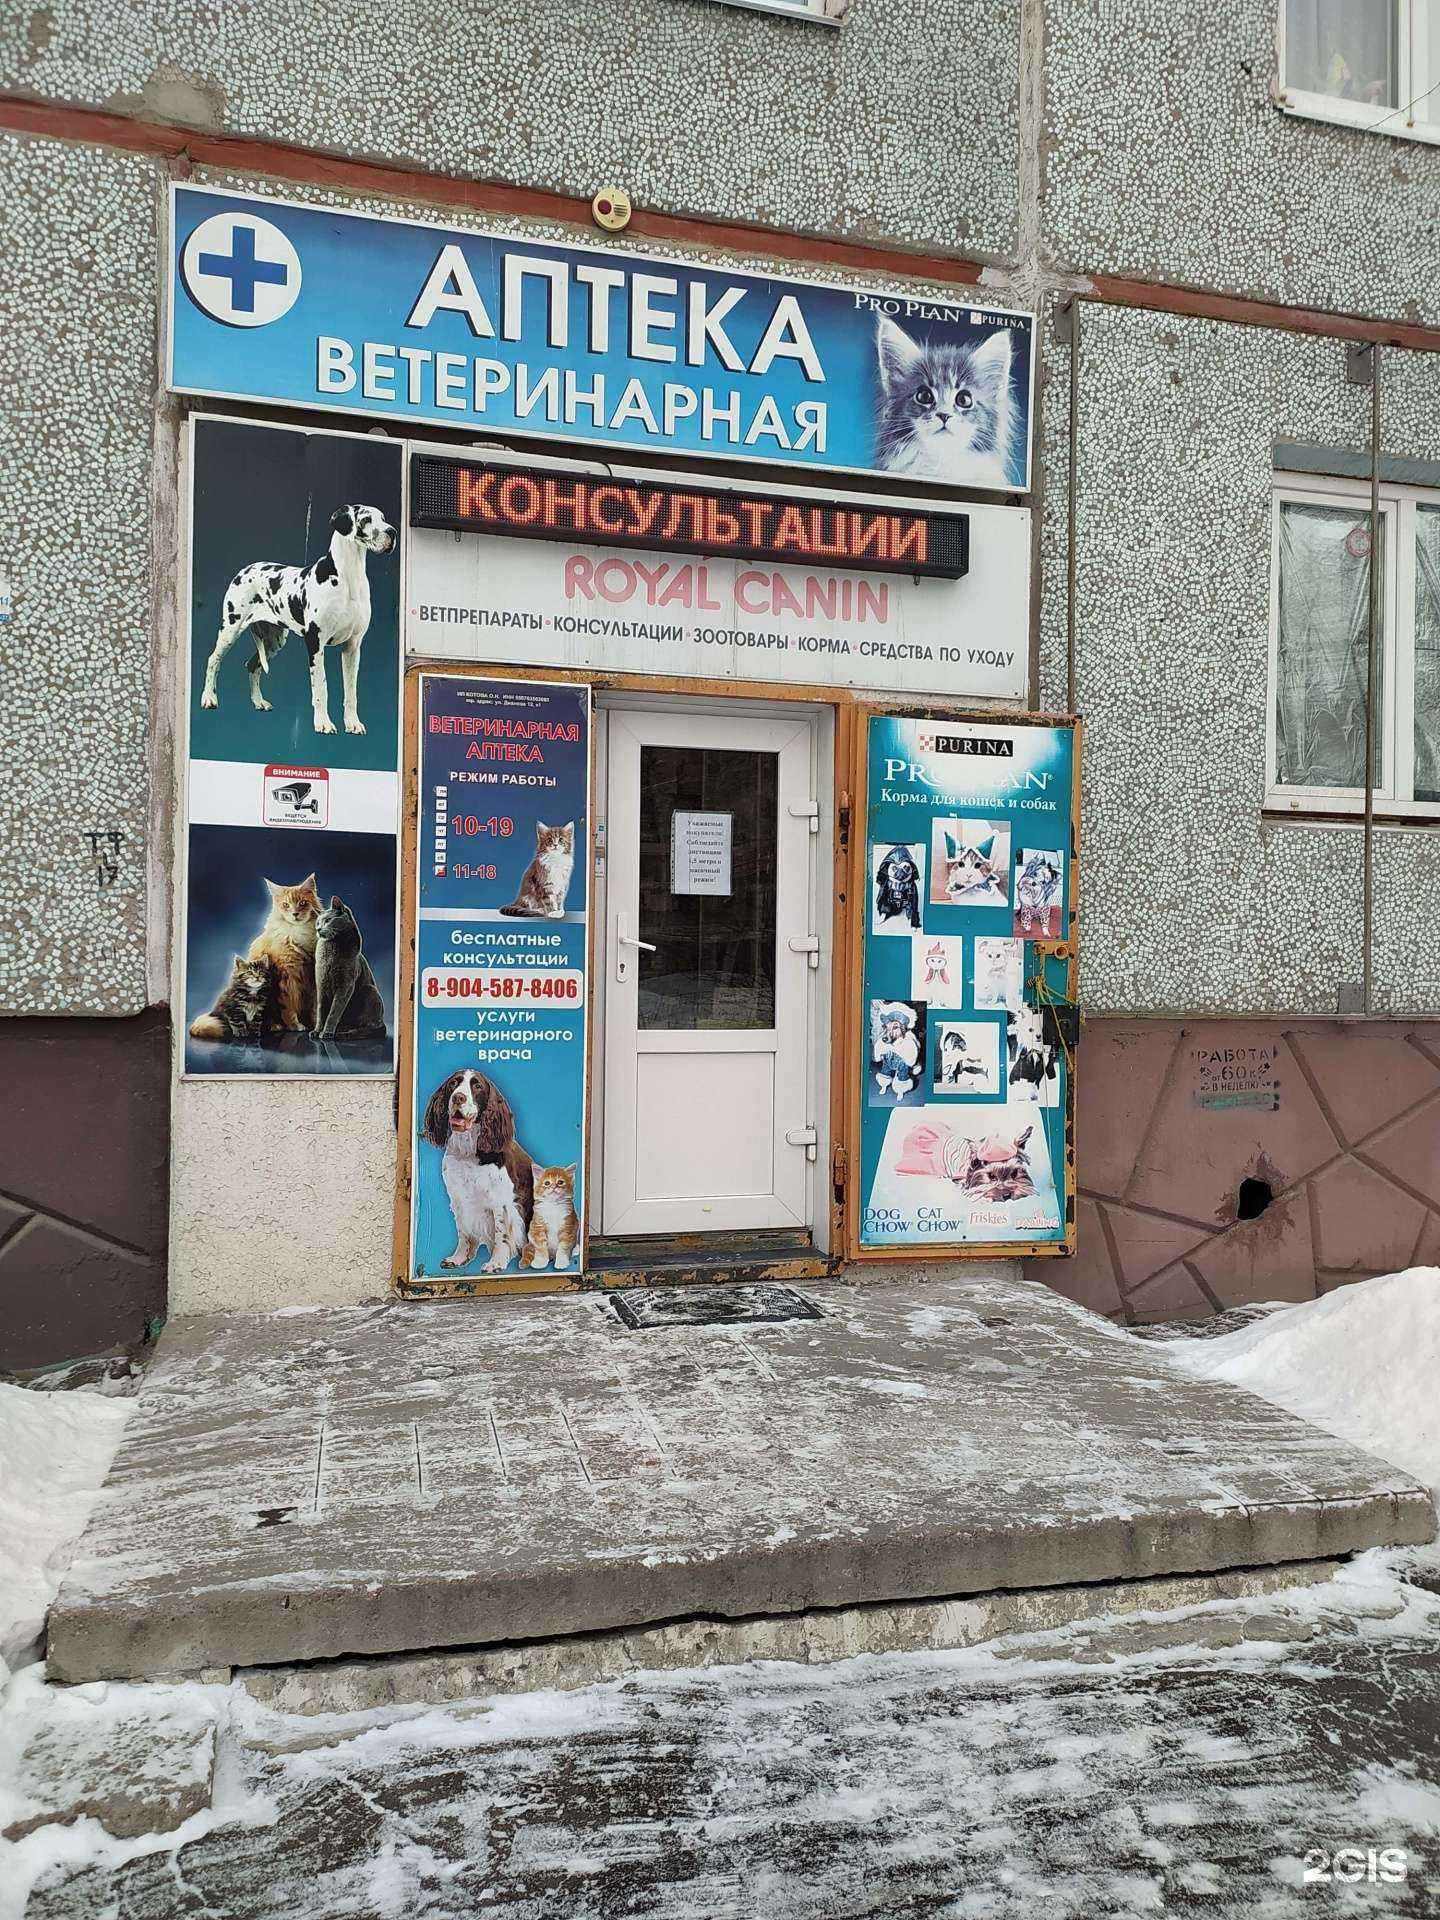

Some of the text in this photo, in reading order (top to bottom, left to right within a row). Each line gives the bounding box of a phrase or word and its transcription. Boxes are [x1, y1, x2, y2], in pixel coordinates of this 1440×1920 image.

[406, 244, 827, 382] АПТЕКА
[854, 293, 960, 323] PRO PLAN
[982, 315, 1025, 329] PURINA
[316, 335, 828, 454] ВЕТЕРИНАРНАЯ
[456, 467, 929, 563] КОНСУЛЬТАЦИИ
[564, 555, 889, 624] ROYAL CANIN
[419, 605, 1014, 668] ВЕТПРЕПАРАТЫ КОНСУЛЬТАЦИИ ЗООТОВАРЫ КОРМА СРЕДСТВА ПО УХОДУ
[429, 715, 580, 742] ВЕТЕРИНАРНАЯ
[466, 741, 544, 763] АПТЕКА
[938, 737, 1011, 756] PURINA
[272, 768, 321, 778] ВНИМАНИЕ
[450, 771, 557, 787] РЕЖИМ РАБОТЫ
[880, 788, 1057, 810] Корма для кошек и собак
[451, 815, 514, 837] 10-19
[452, 863, 497, 879] 11-18
[451, 930, 562, 946] бесплатные
[443, 951, 568, 968] консультации
[427, 977, 578, 998] 8-904-587-8406
[477, 1010, 535, 1025] услуги
[436, 1029, 573, 1044] ветеринарного
[478, 1049, 532, 1062] врача
[864, 1208, 900, 1220] DOG
[917, 1207, 943, 1219] CAT
[969, 1211, 1008, 1225] Friskies
[864, 1221, 910, 1233] CHOW
[917, 1220, 960, 1232] CHOW
